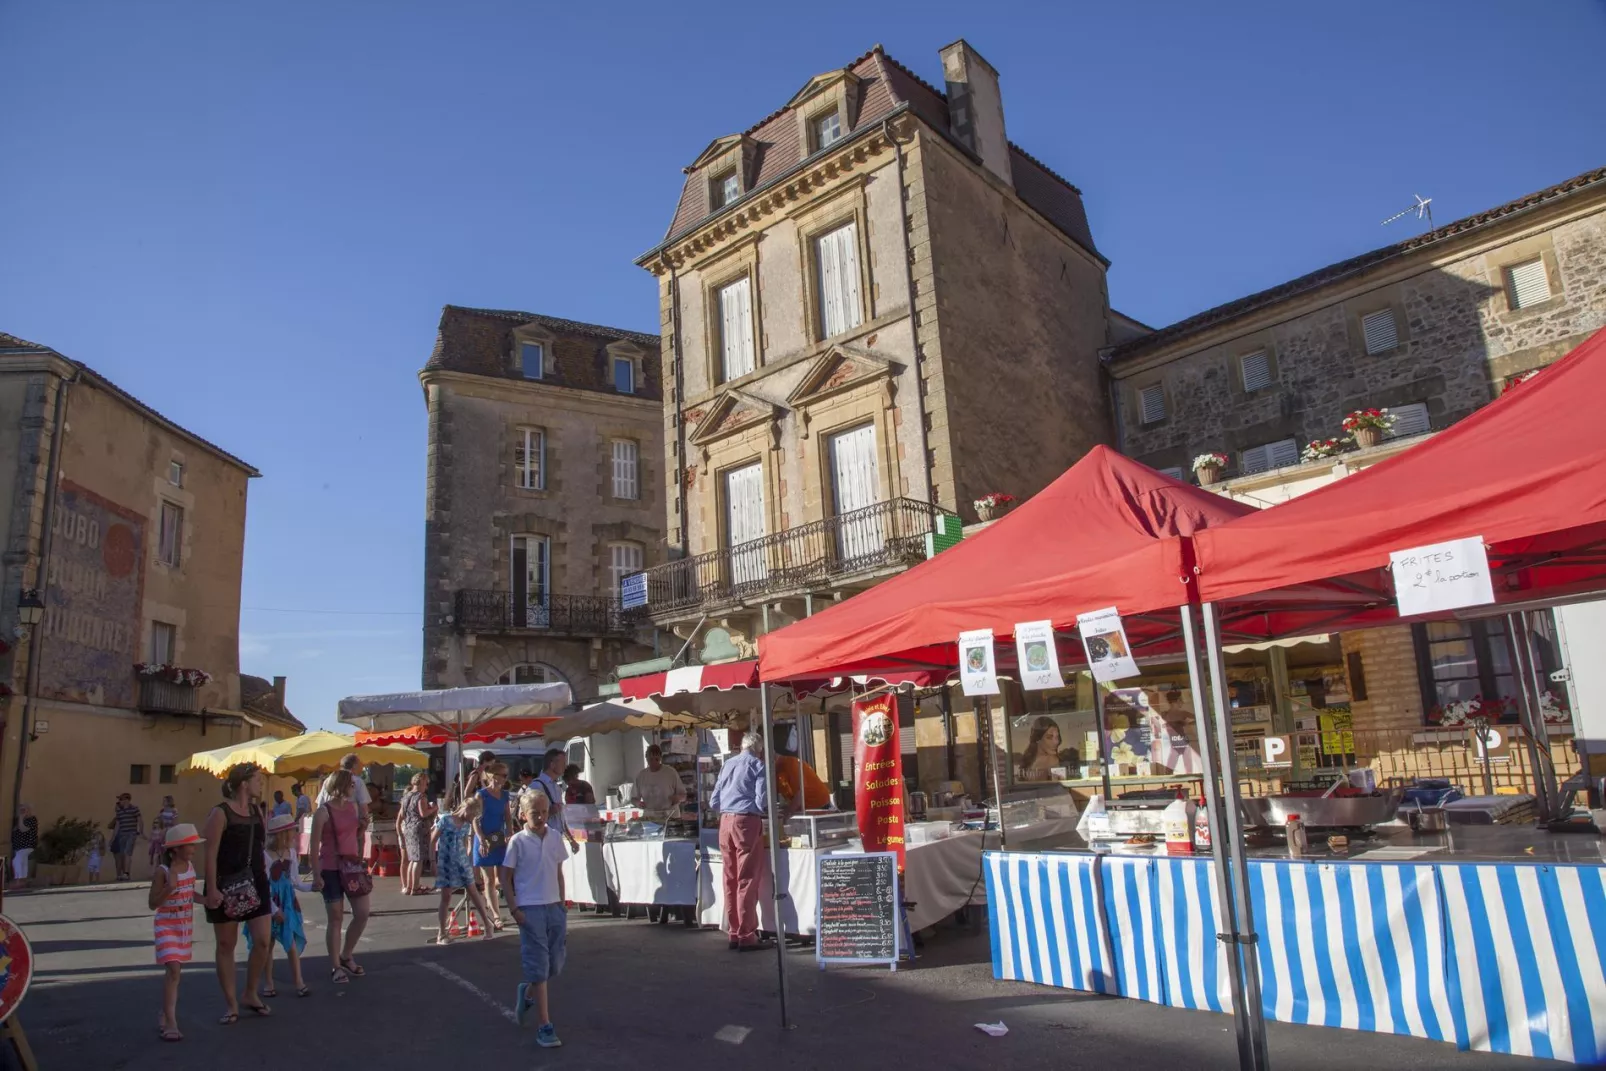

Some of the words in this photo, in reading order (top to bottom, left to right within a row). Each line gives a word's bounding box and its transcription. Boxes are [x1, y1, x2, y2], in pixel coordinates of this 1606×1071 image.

[53, 504, 99, 549] DUBO
[1400, 551, 1454, 568] FRITES
[1449, 571, 1479, 581] portion
[1264, 737, 1285, 762] P
[1475, 729, 1502, 757] P
[865, 759, 896, 772] Entrées
[865, 778, 899, 791] Salades
[877, 836, 904, 846] Légumes
